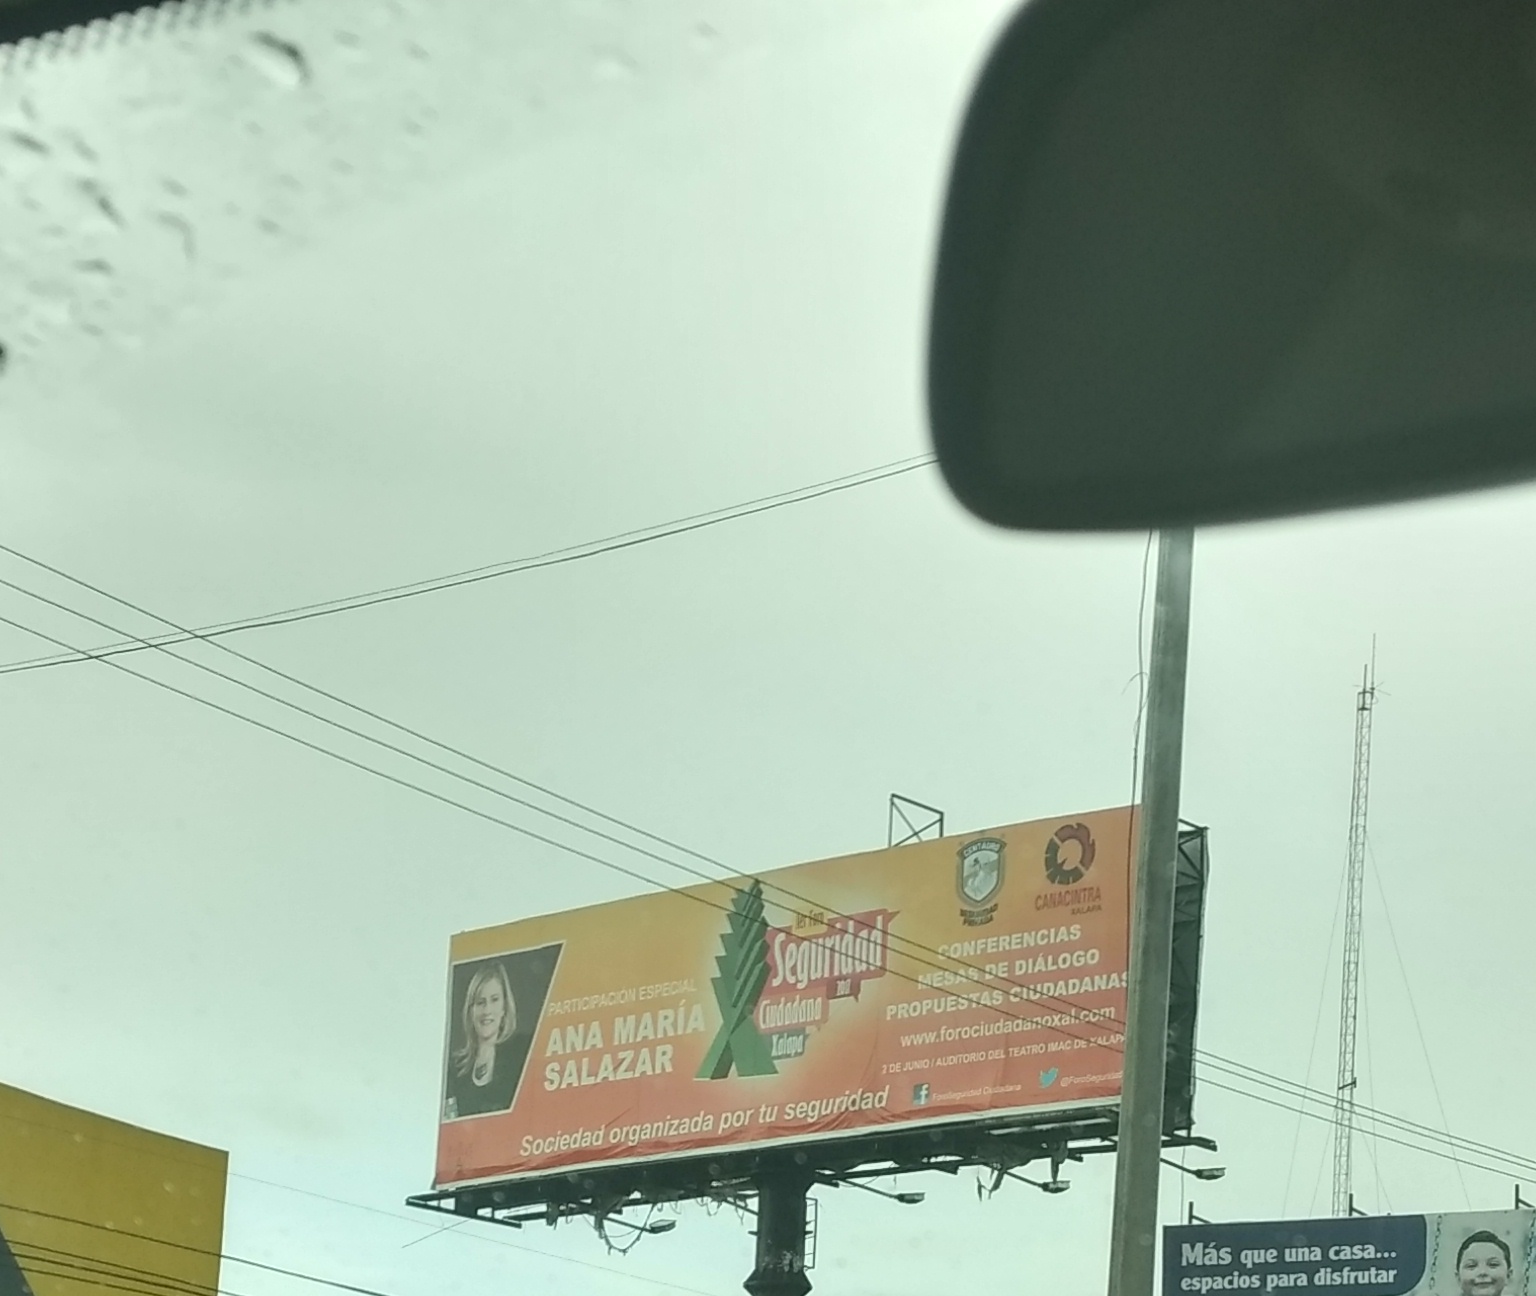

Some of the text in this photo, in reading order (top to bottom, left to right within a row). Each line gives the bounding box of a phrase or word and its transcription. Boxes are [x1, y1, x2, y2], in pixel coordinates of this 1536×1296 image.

[1035, 887, 1101, 911] CANACINTRA
[1071, 904, 1102, 916] XALAPA
[772, 915, 884, 989] Seguridad
[938, 924, 1081, 960] CONFERENCIAS
[917, 948, 1100, 990] MESAS DE DIÁLOGO
[547, 979, 698, 1016] PARTICIPACIÓN ESPECIAL
[759, 994, 822, 1029] Ciudadana
[886, 989, 1003, 1021] PROPUESTAS
[544, 1000, 706, 1057] ANA MARÍA
[771, 1032, 804, 1058] Xalapa
[900, 1006, 1115, 1048] www.forociudadanoxal.com
[544, 1044, 674, 1092] SALAZAR
[889, 1063, 901, 1074] DE
[903, 1059, 930, 1072] JUNIO
[936, 1051, 986, 1068] AUDITORIO
[988, 1049, 1007, 1061] DEL
[1009, 1043, 1046, 1057] TEATRO
[1048, 1040, 1072, 1053] IMAC
[1074, 1038, 1087, 1050] DE
[520, 1086, 889, 1157] Sociedad organizada por tu seguridad
[1180, 1241, 1397, 1269] Más que una casa...
[1180, 1266, 1397, 1294] espacios para disfrutar
